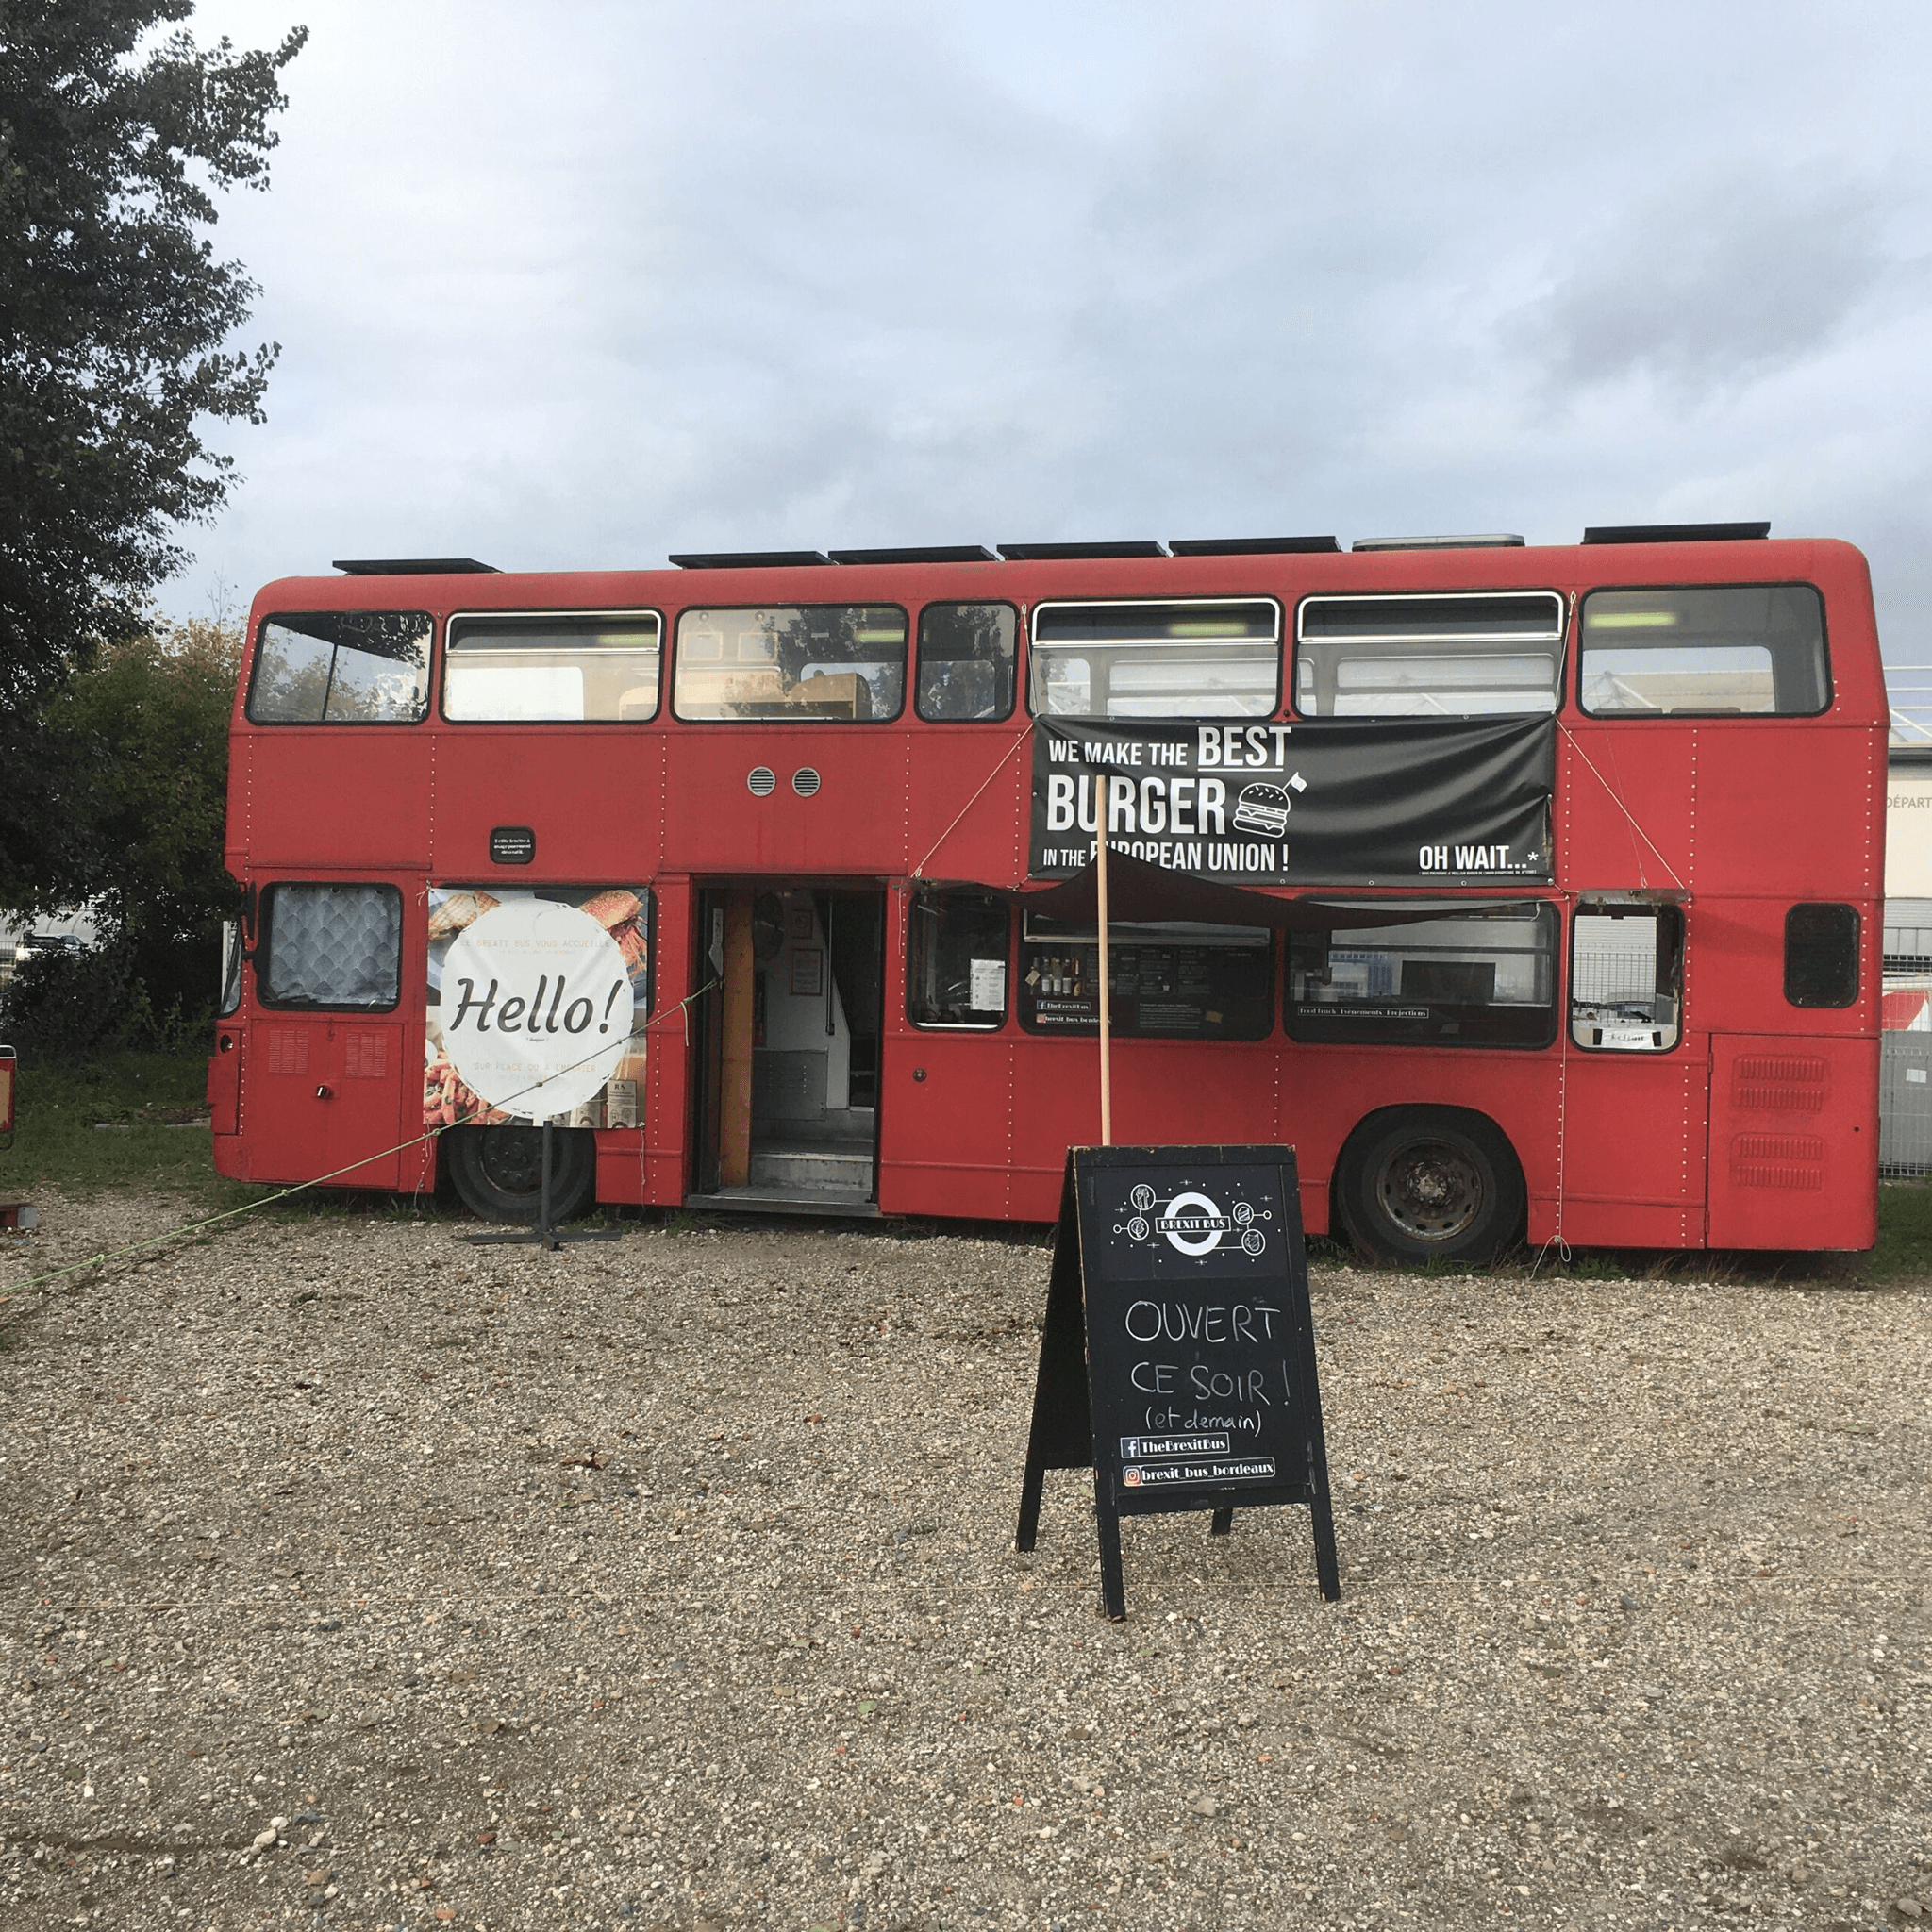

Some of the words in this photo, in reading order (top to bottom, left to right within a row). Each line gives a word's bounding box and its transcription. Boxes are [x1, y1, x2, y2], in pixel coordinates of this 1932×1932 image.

[1048, 740, 1079, 763] WE
[1085, 742, 1142, 766] MAKE
[1148, 743, 1188, 766] THE
[1198, 726, 1291, 766] BEST
[1047, 774, 1226, 835] BURGER
[1043, 849, 1057, 866] IN
[1060, 849, 1086, 867] THE
[1090, 841, 1201, 871] EOPEAN
[1208, 842, 1275, 871] UNION
[1282, 844, 1289, 872] !
[1419, 845, 1448, 870] OH
[449, 974, 624, 1034] Hello!
[1160, 1219, 1200, 1230] BREXIT
[1203, 1219, 1225, 1229] BUS
[1125, 1300, 1280, 1343] OUVERT
[1131, 1361, 1178, 1393] CE
[1191, 1365, 1270, 1406] SOIR
[1282, 1359, 1291, 1406] !
[1145, 1407, 1180, 1429] (et
[1184, 1409, 1261, 1437] demain)
[1141, 1439, 1226, 1454] TheBrexitBus
[1141, 1463, 1274, 1481] brexit_bus_bordeaux
